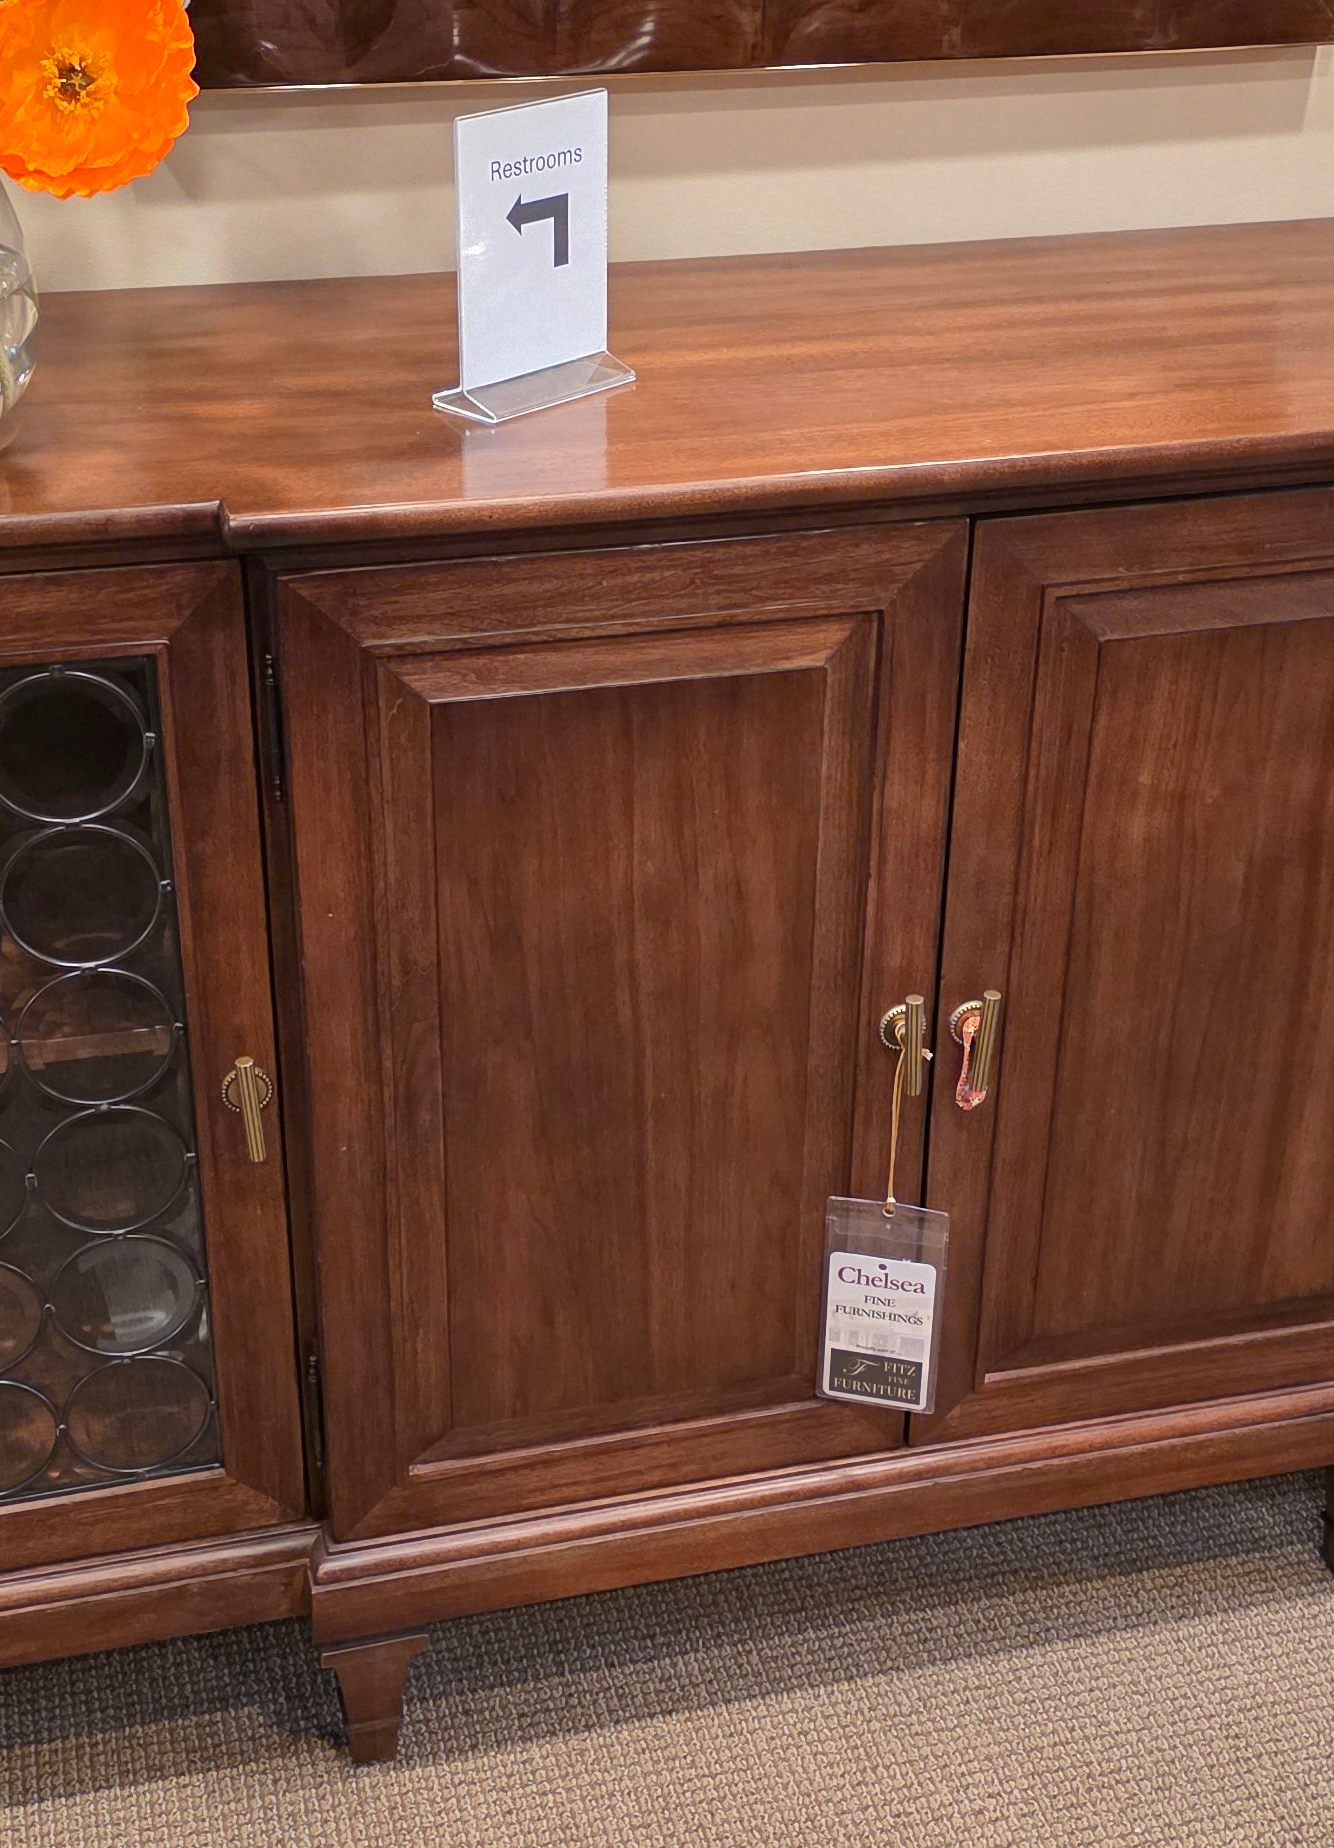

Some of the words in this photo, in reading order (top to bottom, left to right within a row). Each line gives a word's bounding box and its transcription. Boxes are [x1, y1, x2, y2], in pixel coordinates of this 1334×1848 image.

[490, 146, 583, 183] Restrooms
[837, 1266, 926, 1294] Chelsea
[864, 1295, 896, 1308] FINE
[834, 1305, 924, 1327] FURNISHINGS
[884, 1361, 916, 1376] FITZ
[833, 1377, 917, 1400] FURNITURE
[888, 1375, 910, 1385] FINE
